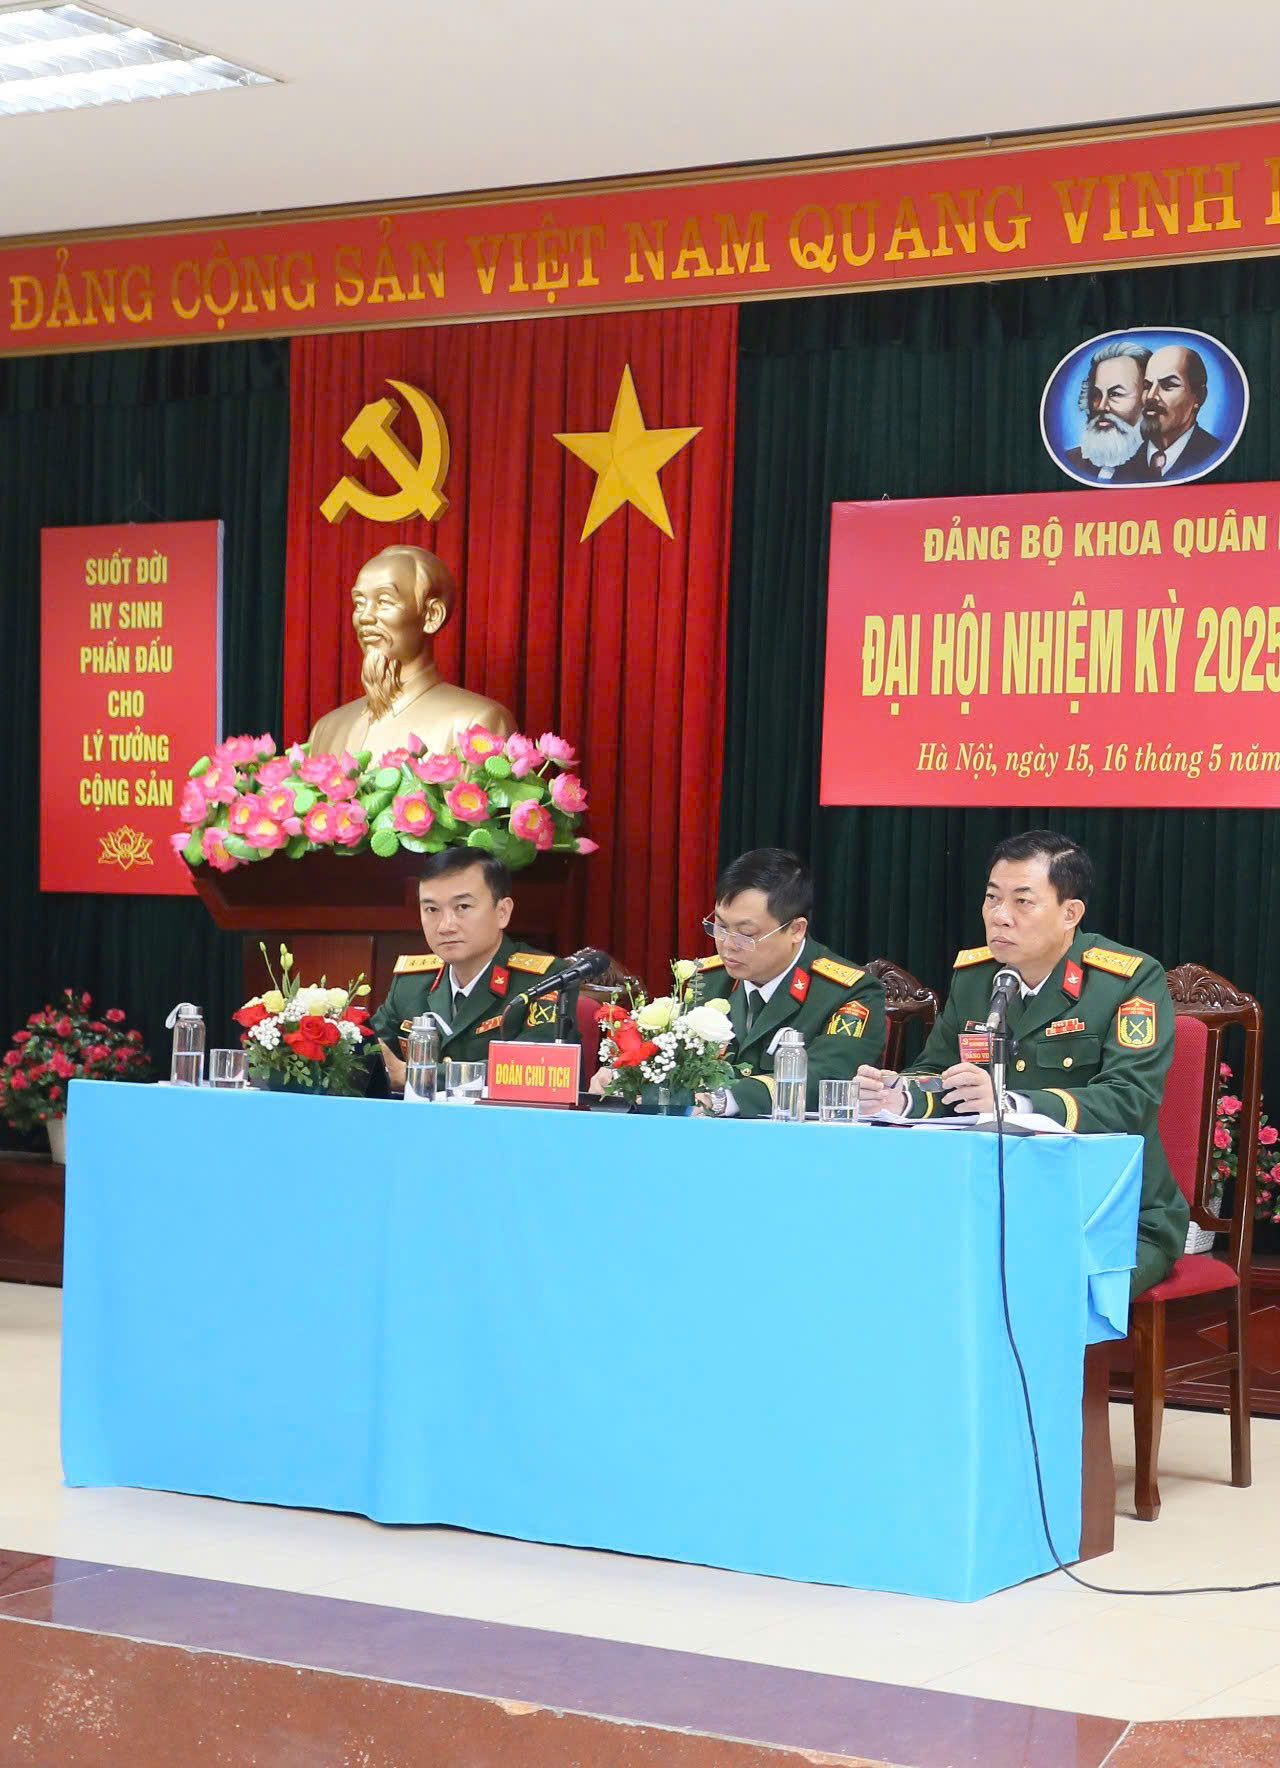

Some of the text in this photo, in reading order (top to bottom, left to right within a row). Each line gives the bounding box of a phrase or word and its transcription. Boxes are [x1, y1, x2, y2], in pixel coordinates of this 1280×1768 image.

[9, 246, 153, 330] ĐẢNG
[170, 240, 318, 330] CỘNG
[334, 214, 448, 307] SẢN
[465, 211, 607, 304] VIỆT
[624, 211, 771, 284] NAM
[788, 184, 1032, 273] QUANG
[1053, 161, 1242, 245] VINH
[922, 515, 1011, 563] ĐẢNG
[1021, 515, 1063, 566] BỘ
[1074, 519, 1163, 557] KHOA
[1172, 508, 1266, 557] QUÂN
[85, 548, 168, 585] SUỐT ĐỜI
[88, 600, 164, 630] HY SINH
[80, 636, 173, 673] PHẤN ĐẤU
[861, 614, 919, 716] ĐẠI
[930, 594, 992, 715] HỘI
[1001, 591, 1124, 714] NHIỆM
[1134, 589, 1185, 694] KỲ
[107, 689, 145, 718] CHO
[82, 725, 169, 762] LÝ TƯỞNG
[916, 742, 949, 772] Hà
[954, 741, 998, 780] Nội,
[1005, 743, 1059, 778] ngày
[1064, 742, 1095, 778] 15,
[1101, 742, 1128, 773] 16
[1134, 742, 1203, 779] tháng
[1207, 743, 1223, 773] 5
[79, 770, 174, 811] CỘNG SẢN
[525, 1056, 546, 1087] CHỦ
[547, 1065, 571, 1092] TỊCH
